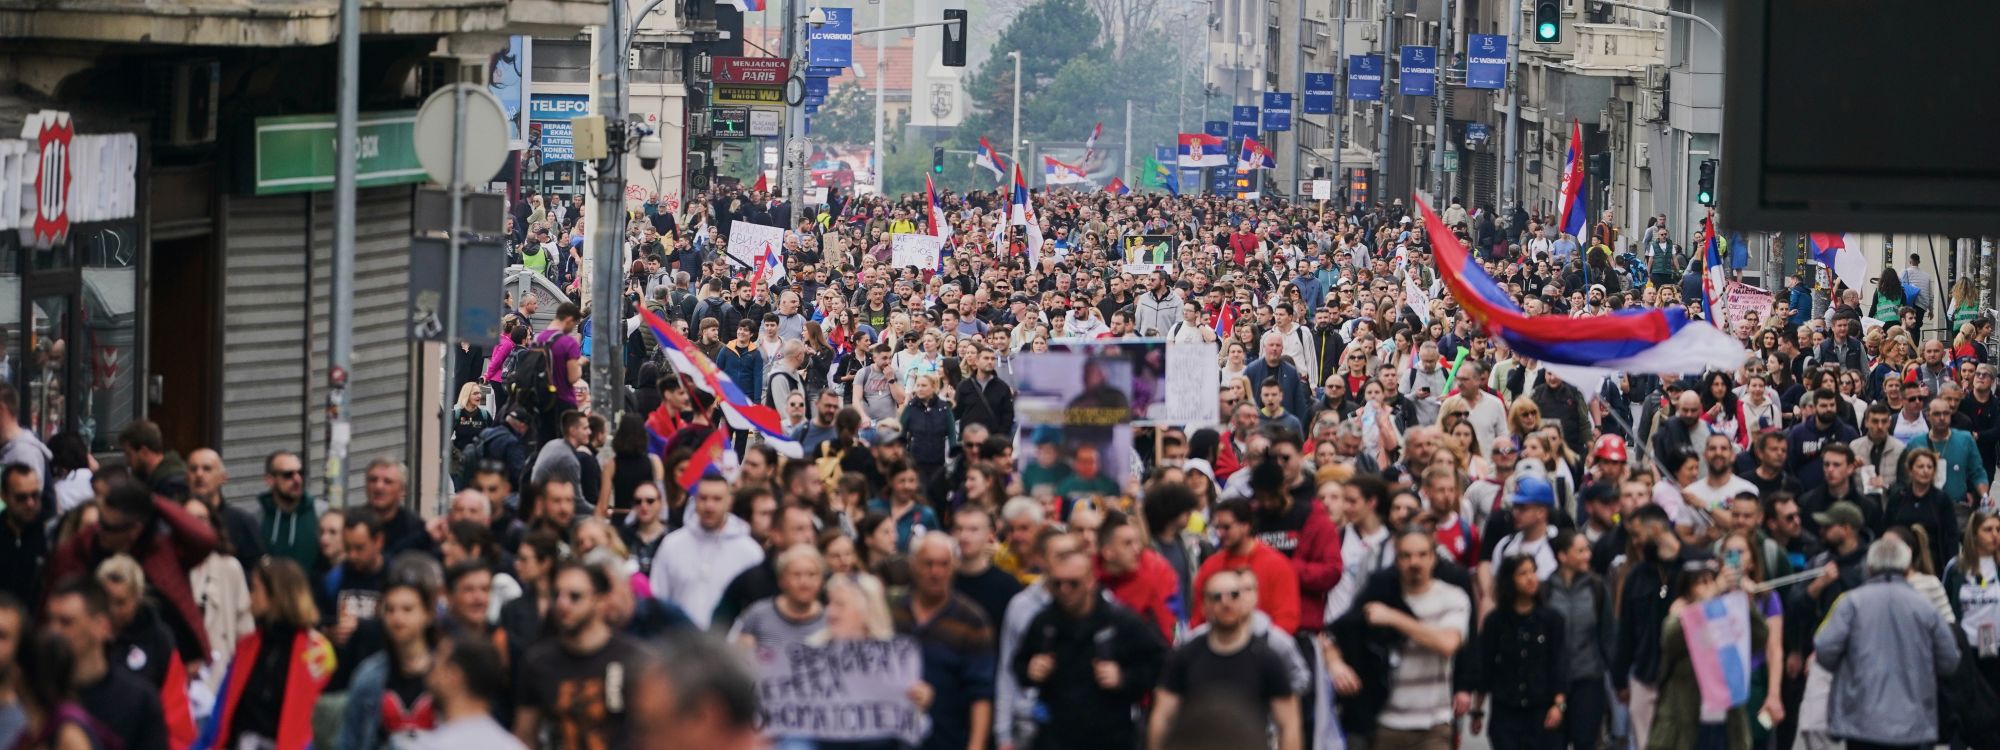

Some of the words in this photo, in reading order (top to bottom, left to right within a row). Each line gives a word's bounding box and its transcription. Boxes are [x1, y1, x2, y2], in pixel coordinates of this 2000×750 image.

[827, 10, 837, 20] 15
[1484, 38, 1492, 46] 15
[742, 71, 776, 80] PARIS
[760, 90, 780, 100] WU
